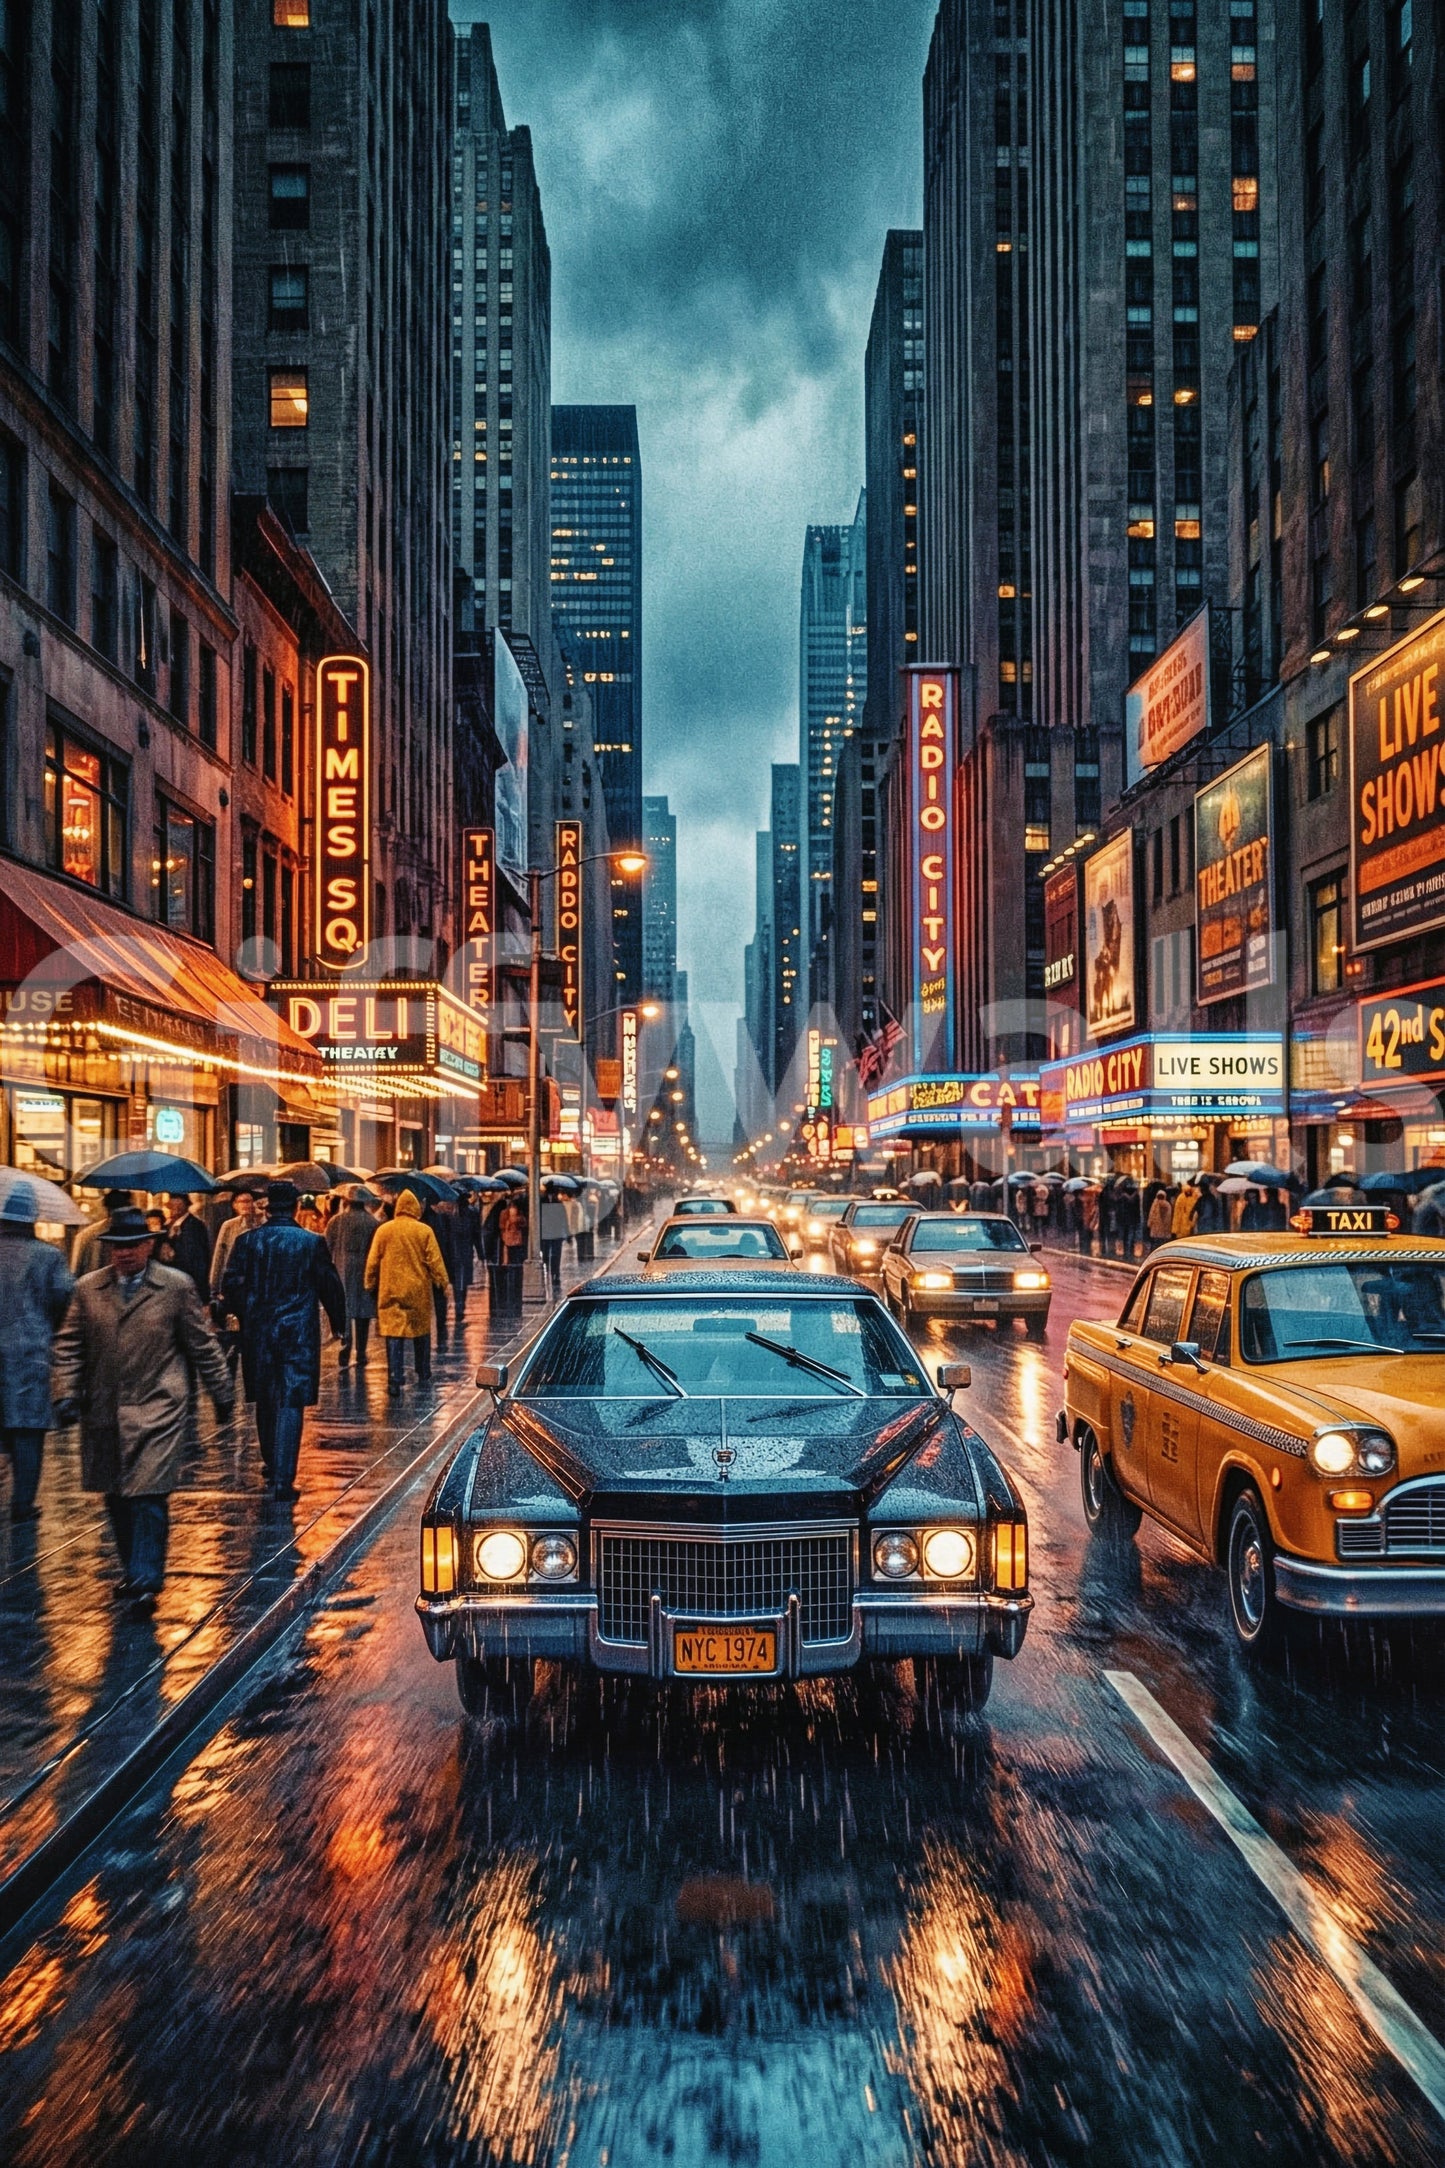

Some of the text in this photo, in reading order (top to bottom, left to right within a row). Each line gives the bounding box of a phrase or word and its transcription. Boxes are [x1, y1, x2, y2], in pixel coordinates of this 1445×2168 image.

[1379, 662, 1440, 762] LIVE
[920, 683, 946, 830] RADIO
[325, 672, 364, 953] TIMES SQ.
[468, 835, 490, 1010] THEATER
[560, 830, 578, 1028] RADDO CITY
[921, 855, 946, 972] CITY
[289, 997, 408, 1040] DELI
[1366, 1004, 1424, 1069] 42nd
[970, 1082, 1040, 1107] CAT
[1066, 1047, 1143, 1102] RADIO CITY
[1158, 1056, 1278, 1075] LIVE SHOWS
[1327, 1212, 1372, 1230] TAXI
[681, 1637, 767, 1662] NYC 1974
